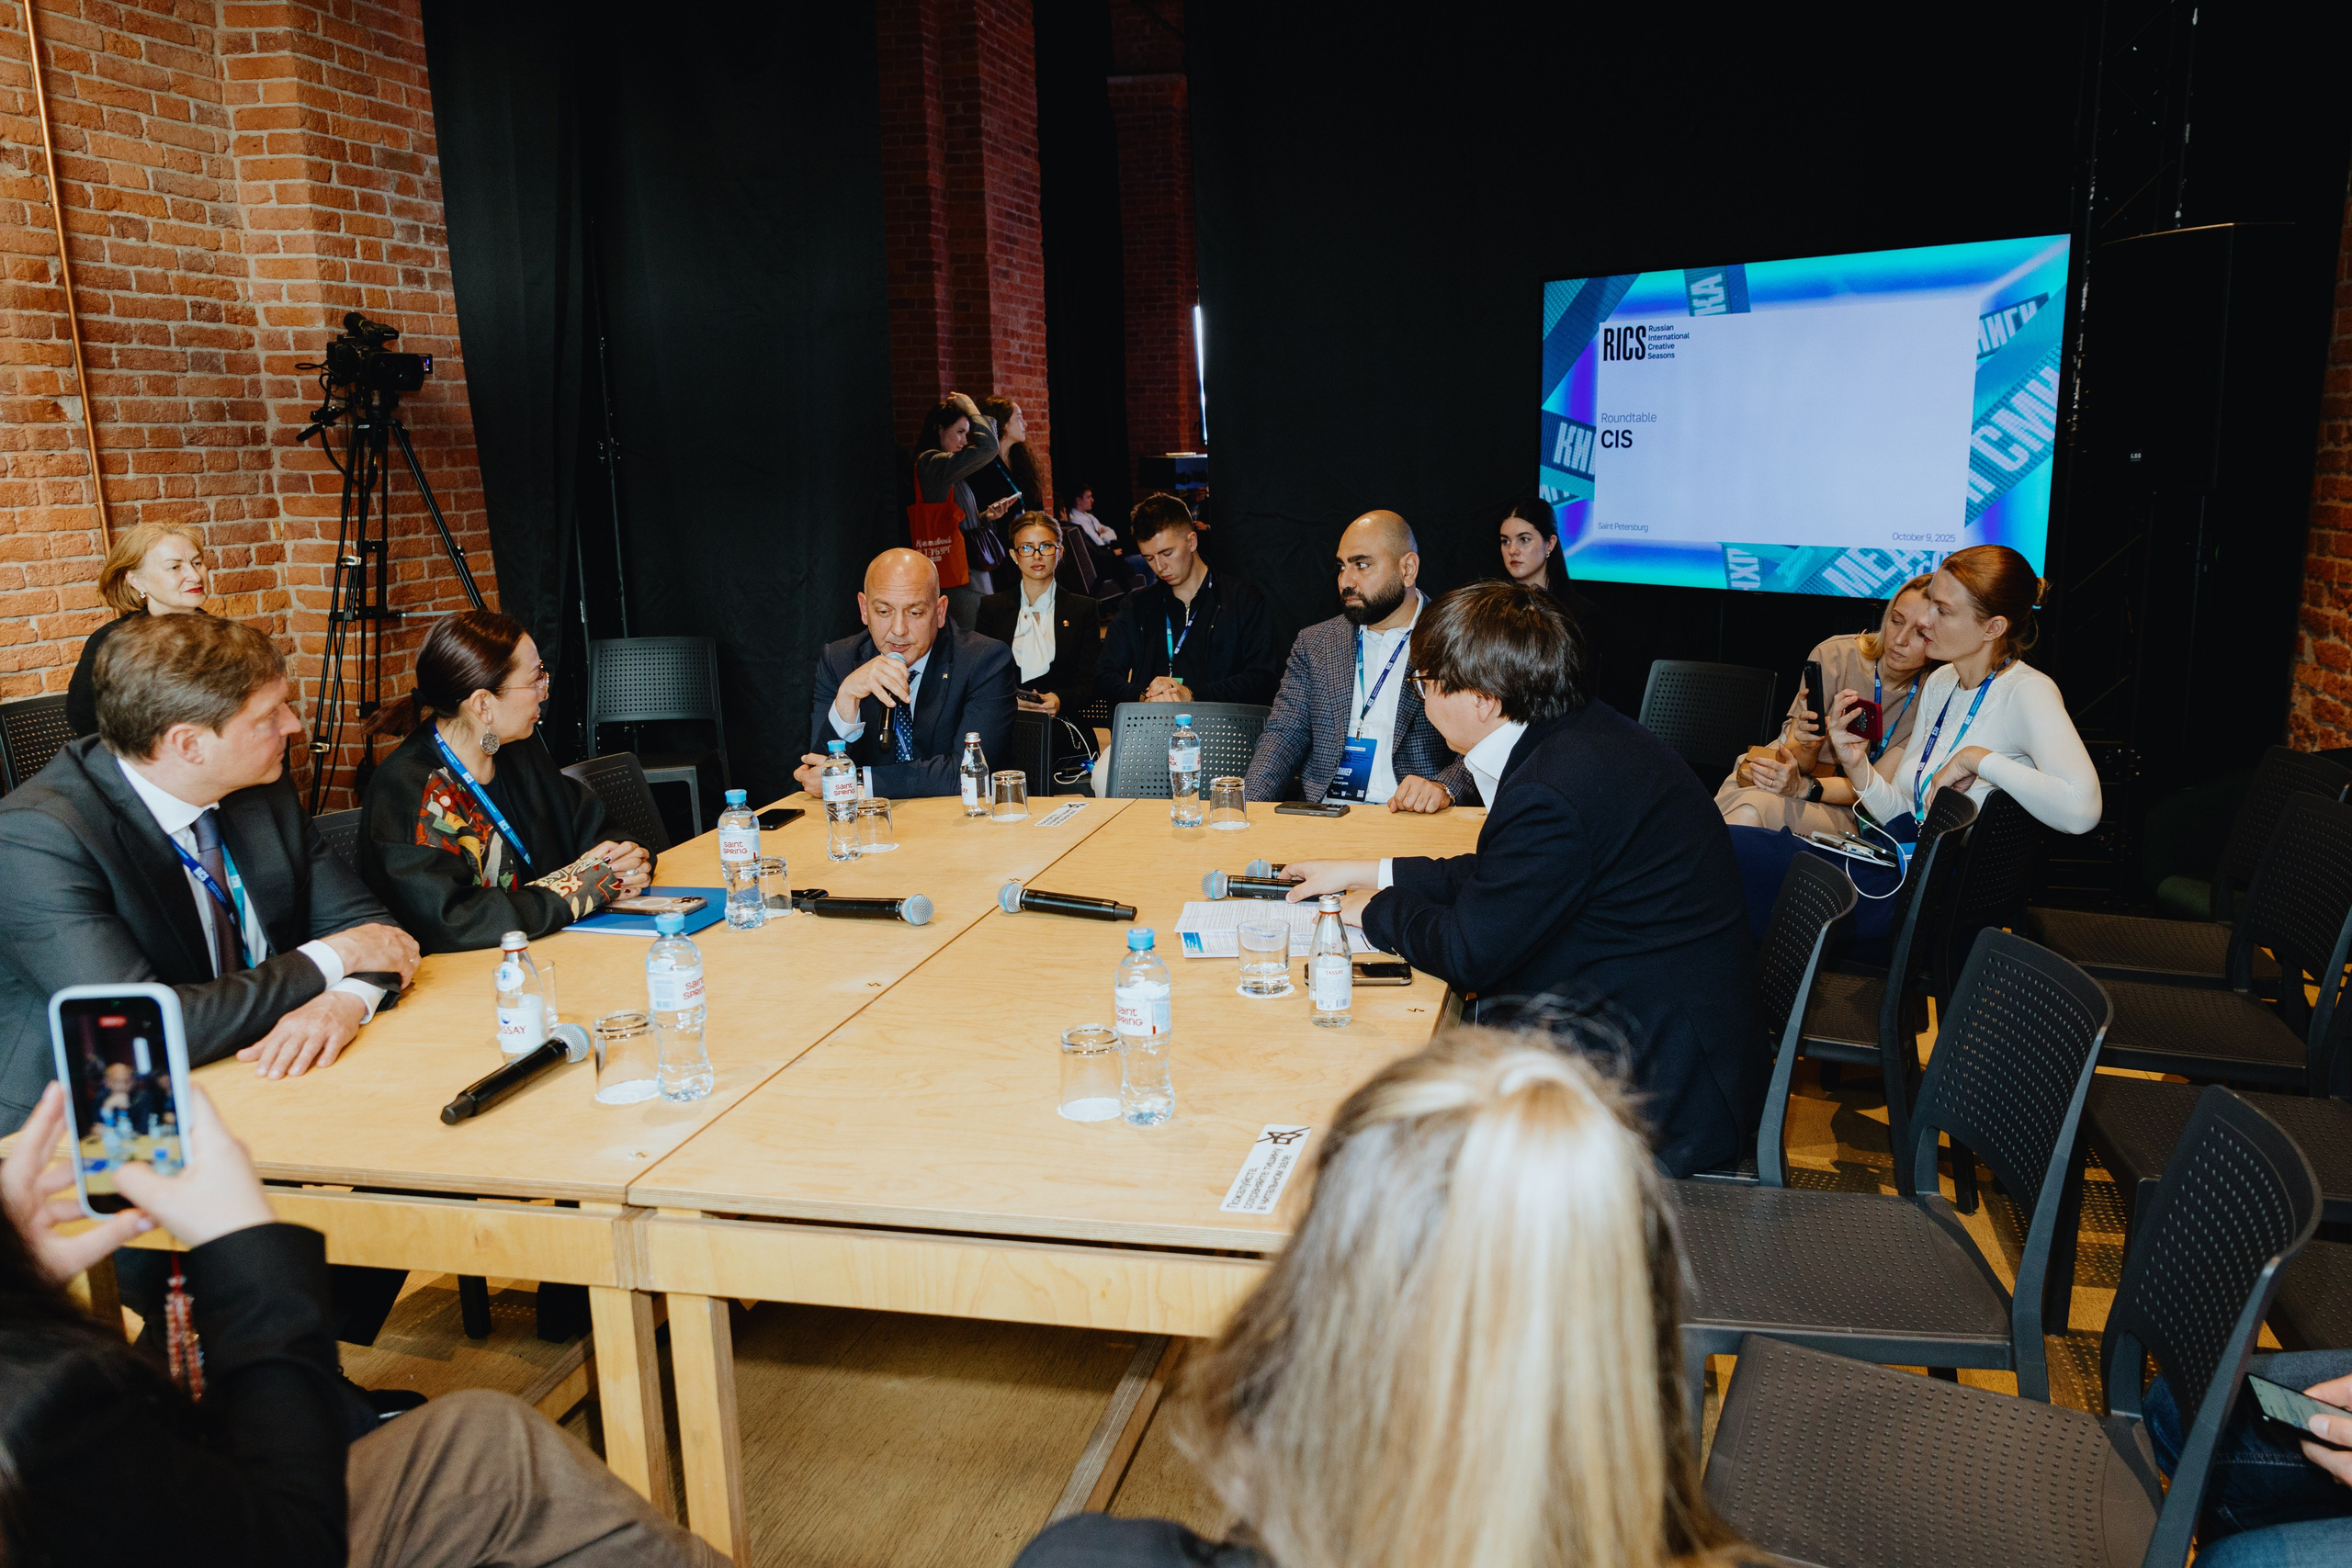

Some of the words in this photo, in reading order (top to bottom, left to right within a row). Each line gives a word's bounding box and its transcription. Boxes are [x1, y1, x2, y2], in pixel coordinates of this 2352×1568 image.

[1648, 324, 1674, 333] Russian
[1647, 333, 1690, 341] International
[1603, 325, 1646, 361] RICS
[1647, 342, 1675, 351] Creative
[1601, 412, 1657, 423] Roundtable
[1600, 429, 1633, 448] CIS
[1598, 522, 1613, 530] Saint
[1614, 523, 1648, 533] Petersburg
[1893, 532, 1925, 541] October
[1926, 533, 1933, 543] 9,
[1935, 534, 1956, 542] 2025
[193, 865, 209, 882] RICS
[1244, 1171, 1270, 1210] сохраняйте
[1263, 1147, 1283, 1170] тишину
[1261, 1169, 1283, 1205] читальном
[1278, 1154, 1292, 1169] зале
